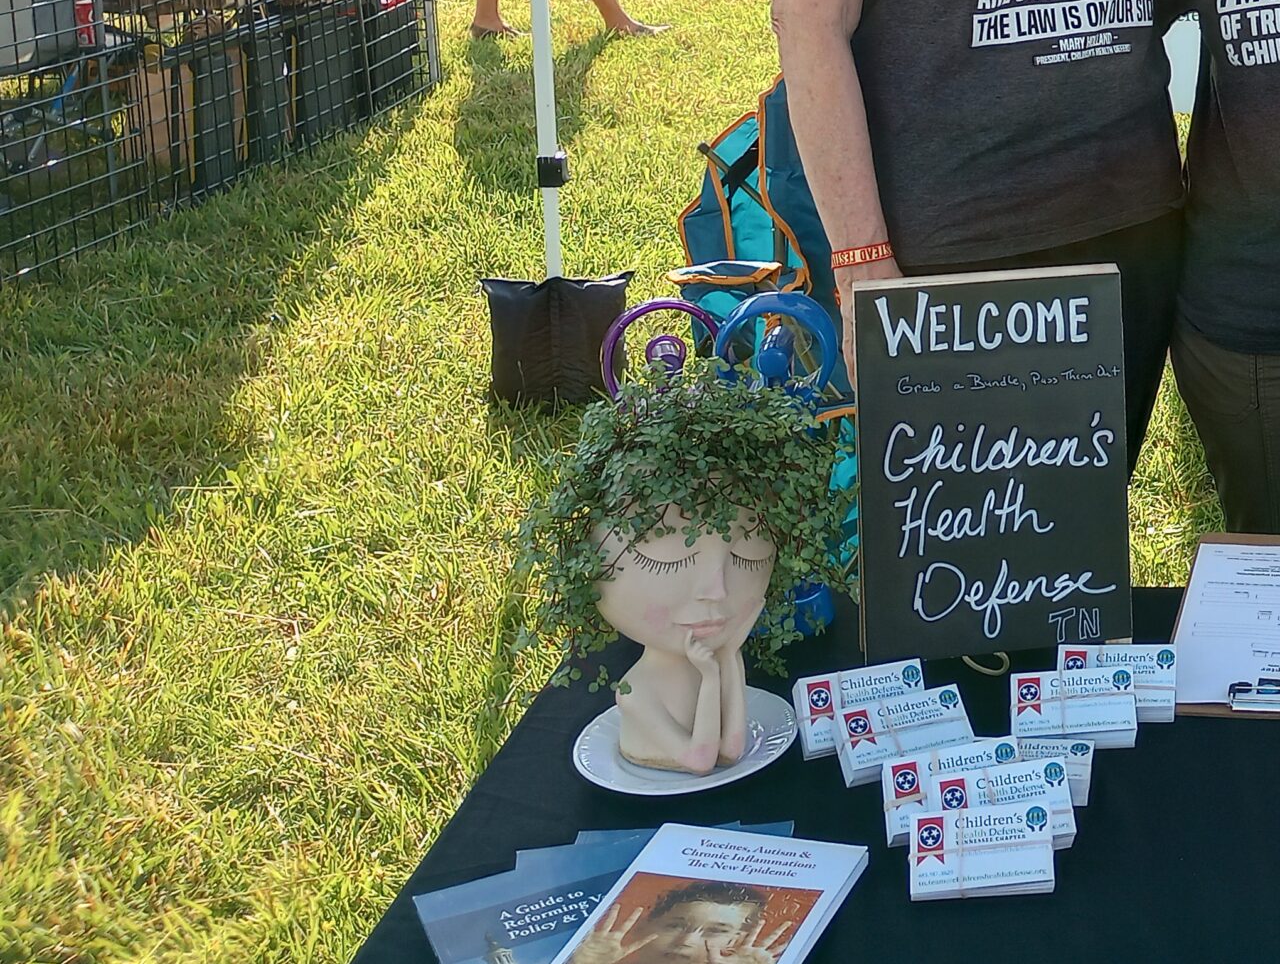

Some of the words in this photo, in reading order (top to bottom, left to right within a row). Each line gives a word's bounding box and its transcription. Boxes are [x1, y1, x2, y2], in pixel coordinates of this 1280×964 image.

[1016, 7, 1057, 38] LAW
[1220, 11, 1243, 41] OF
[1059, 36, 1085, 52] MARY
[1225, 43, 1242, 68] &
[874, 290, 1090, 358] WELCOME
[897, 375, 941, 395] Grab
[953, 382, 965, 390] a
[966, 373, 1027, 391] Bundle,
[884, 412, 1113, 482] Children's
[894, 478, 1055, 558] Health
[912, 559, 1116, 639] Defense
[1049, 606, 1101, 643] TN
[1096, 653, 1154, 663] Children's
[841, 672, 900, 691] Children's
[871, 684, 903, 695] Defense
[878, 697, 937, 717] Children's
[955, 812, 1023, 829] Children's
[989, 827, 1025, 836] Defense
[681, 847, 729, 861] Chronic
[731, 853, 816, 870] Inflammation:
[699, 838, 751, 853] Vaccines,
[752, 845, 796, 858] Autism
[687, 859, 708, 869] The
[711, 861, 739, 872] New
[741, 865, 797, 879] Epidemic
[502, 899, 589, 930] Reforming
[515, 896, 560, 915] Guide
[508, 919, 557, 940] Policy
